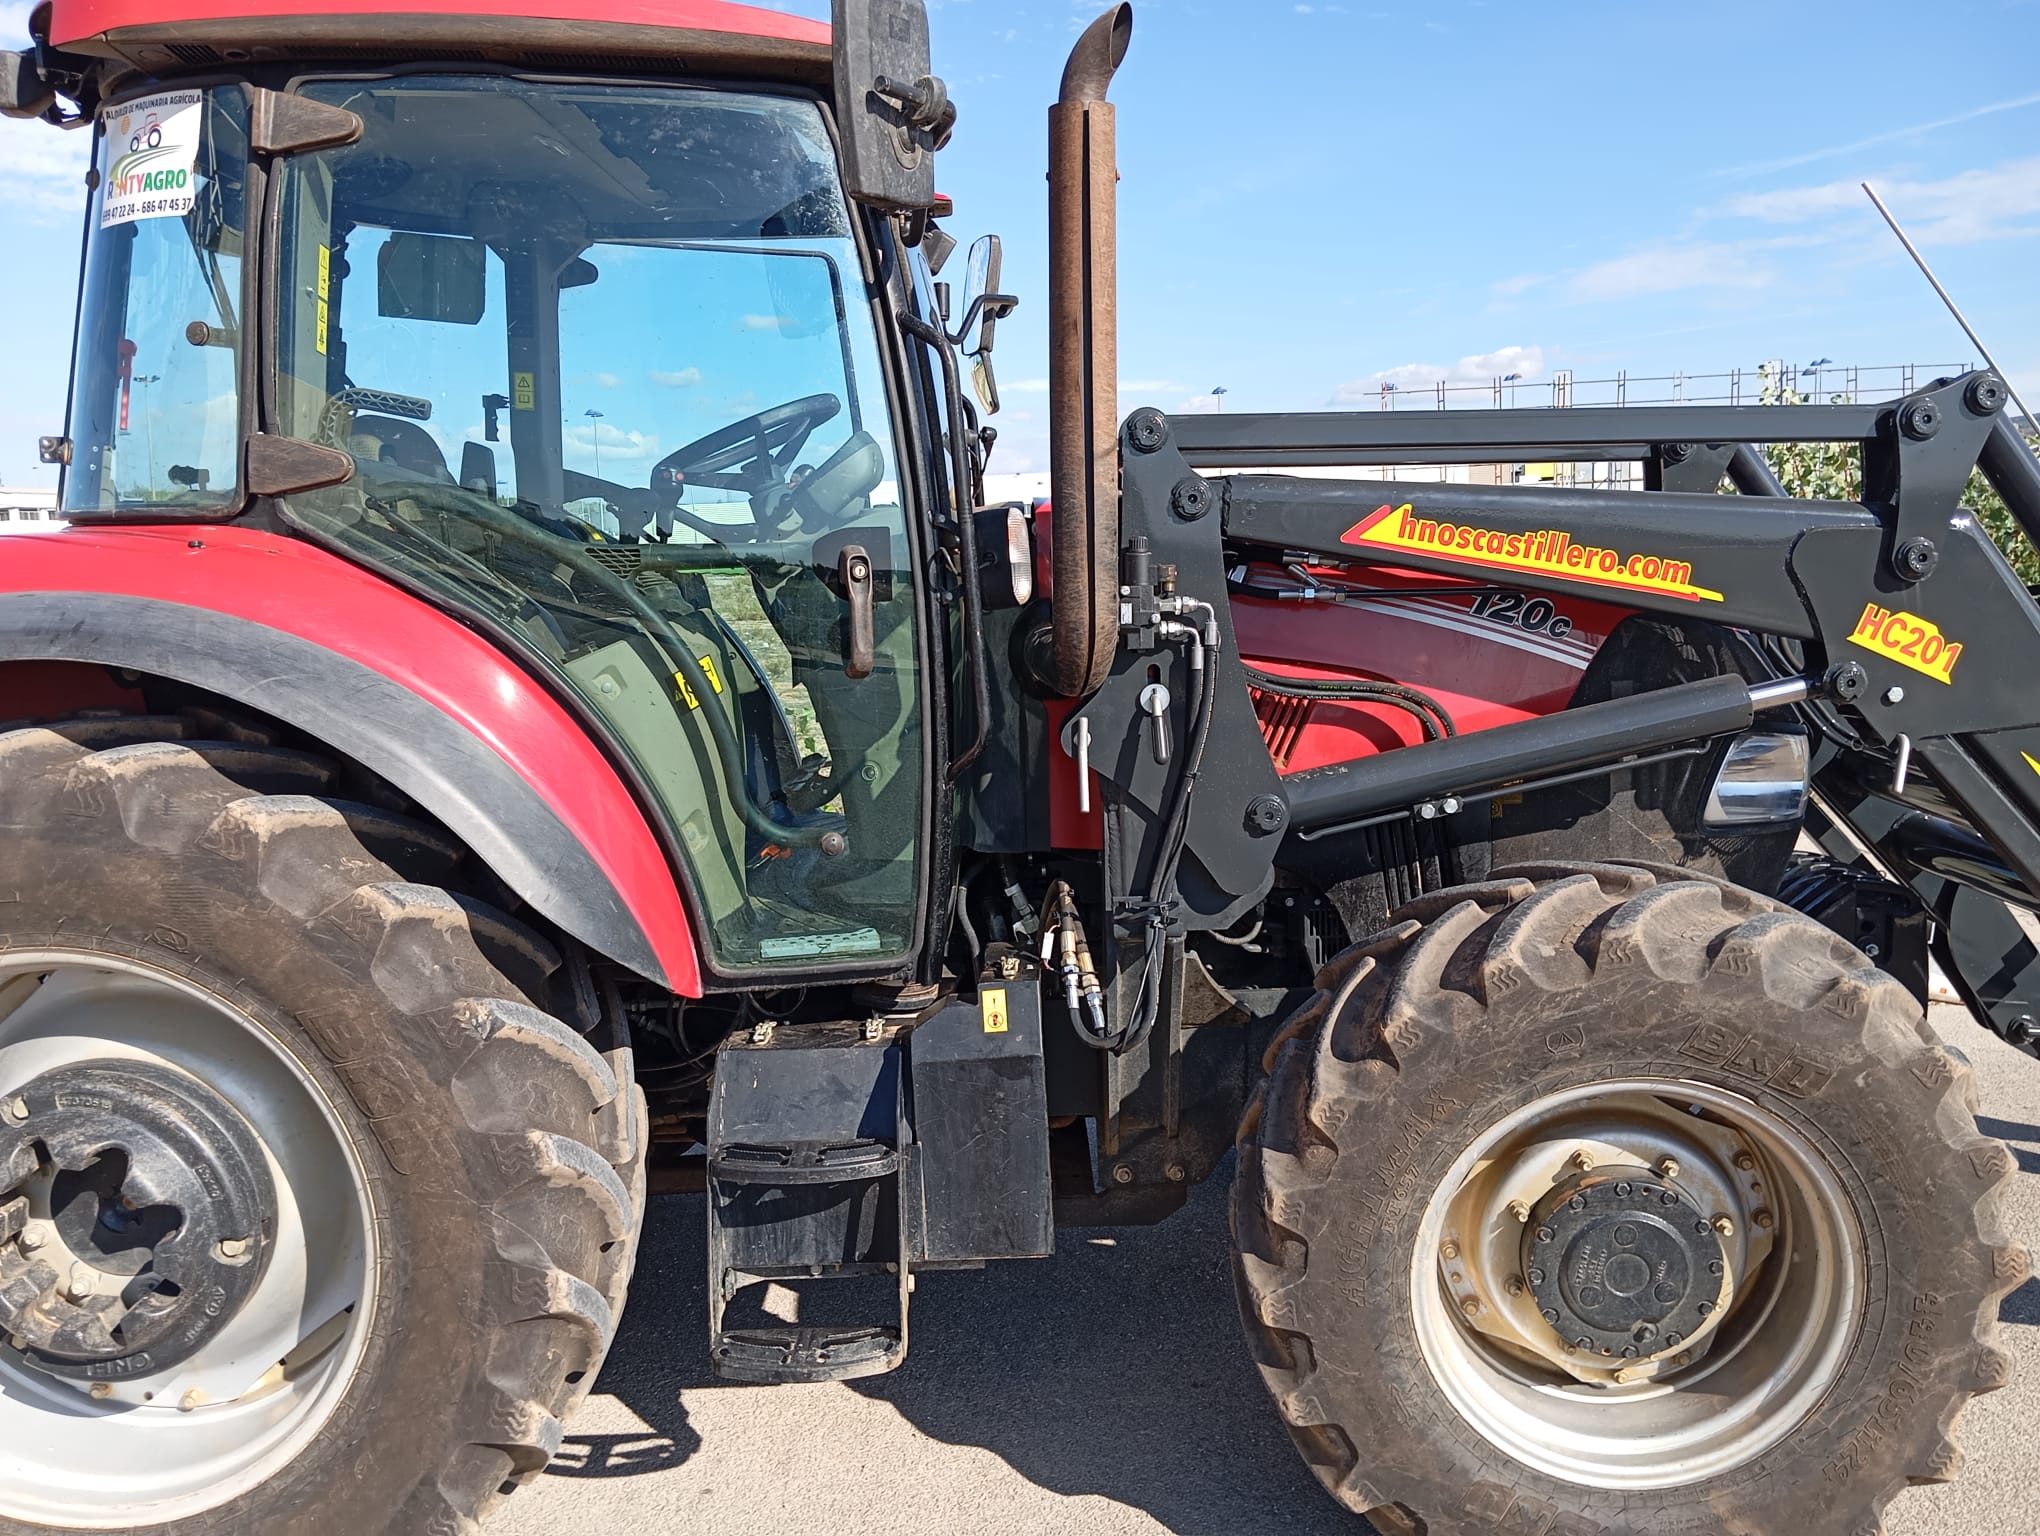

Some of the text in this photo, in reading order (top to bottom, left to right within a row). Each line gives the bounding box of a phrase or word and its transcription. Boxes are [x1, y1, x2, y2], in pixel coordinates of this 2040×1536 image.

[134, 97, 169, 112] MAQUINARIA
[169, 92, 202, 105] AGRÍCOLA
[141, 200, 157, 214] 686
[157, 199, 169, 212] 47
[168, 198, 180, 211] 45
[180, 197, 192, 211] 37
[1398, 507, 1692, 585] hnoscastillero.com
[1856, 604, 1961, 674] HC201
[1678, 1021, 1841, 1099] BKT
